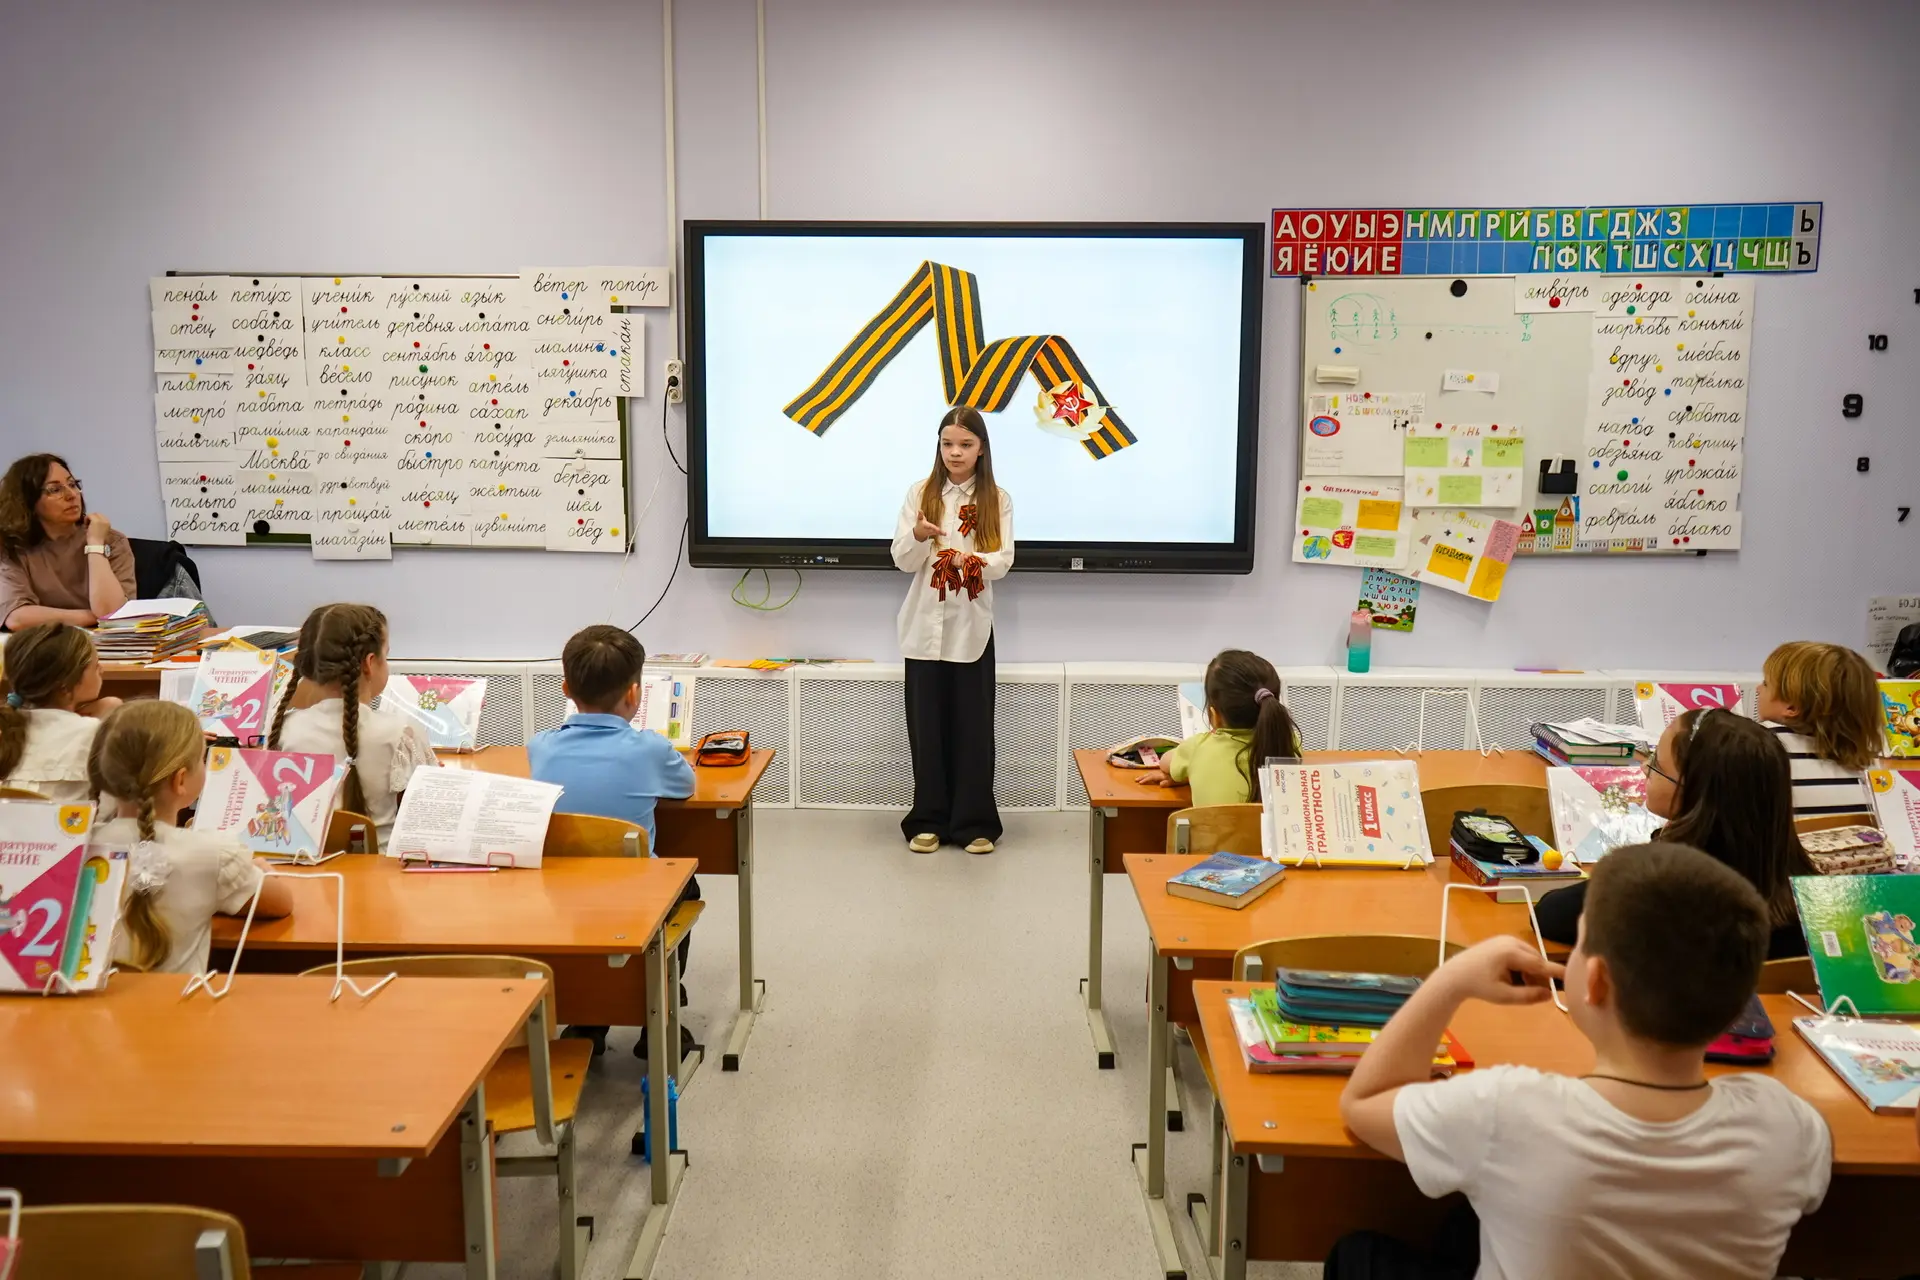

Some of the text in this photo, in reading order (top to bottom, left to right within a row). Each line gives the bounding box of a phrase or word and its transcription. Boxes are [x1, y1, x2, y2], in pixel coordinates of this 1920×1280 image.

[319, 345, 371, 358] класс
[1868, 334, 1888, 351] 10
[1842, 393, 1864, 419] 9
[317, 452, 329, 464] до
[1856, 456, 1870, 473] 8
[1897, 507, 1910, 522] 7
[237, 698, 261, 729] 2
[272, 756, 315, 784] 2
[1311, 770, 1328, 854] ГРАМОТНОСТЬ
[1363, 791, 1374, 821] КЛАСС
[18, 898, 62, 957] 2
